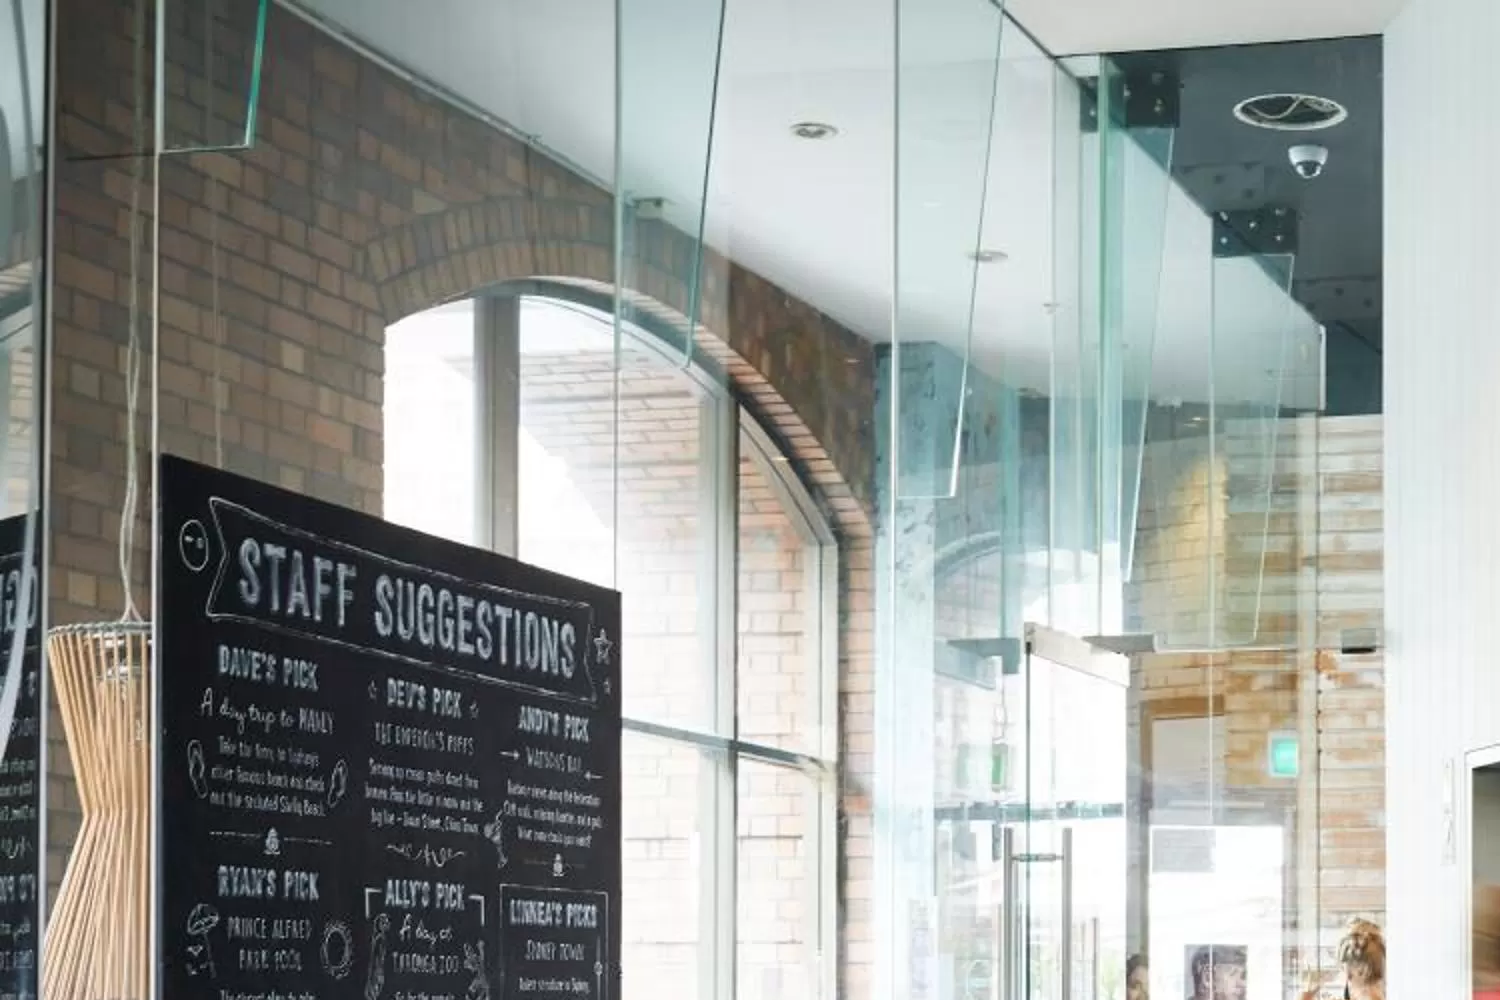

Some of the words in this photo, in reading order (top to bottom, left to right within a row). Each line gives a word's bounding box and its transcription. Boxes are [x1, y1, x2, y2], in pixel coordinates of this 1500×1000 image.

[238, 536, 357, 627] STAFF
[373, 573, 577, 680] SUGGESTIONS
[218, 642, 276, 685] DAVE'S
[283, 655, 319, 693] PICK
[201, 685, 213, 717] A
[219, 696, 245, 735] day
[248, 702, 274, 734] trip
[280, 708, 294, 728] to
[432, 686, 461, 719] PICK
[564, 713, 589, 744] PICK
[217, 864, 276, 899] RYAN'S
[283, 869, 319, 902] PICK
[384, 877, 430, 909] ALLY'S
[435, 881, 464, 911] PICK
[227, 915, 267, 942] PRINCE
[566, 901, 597, 929] PICKS
